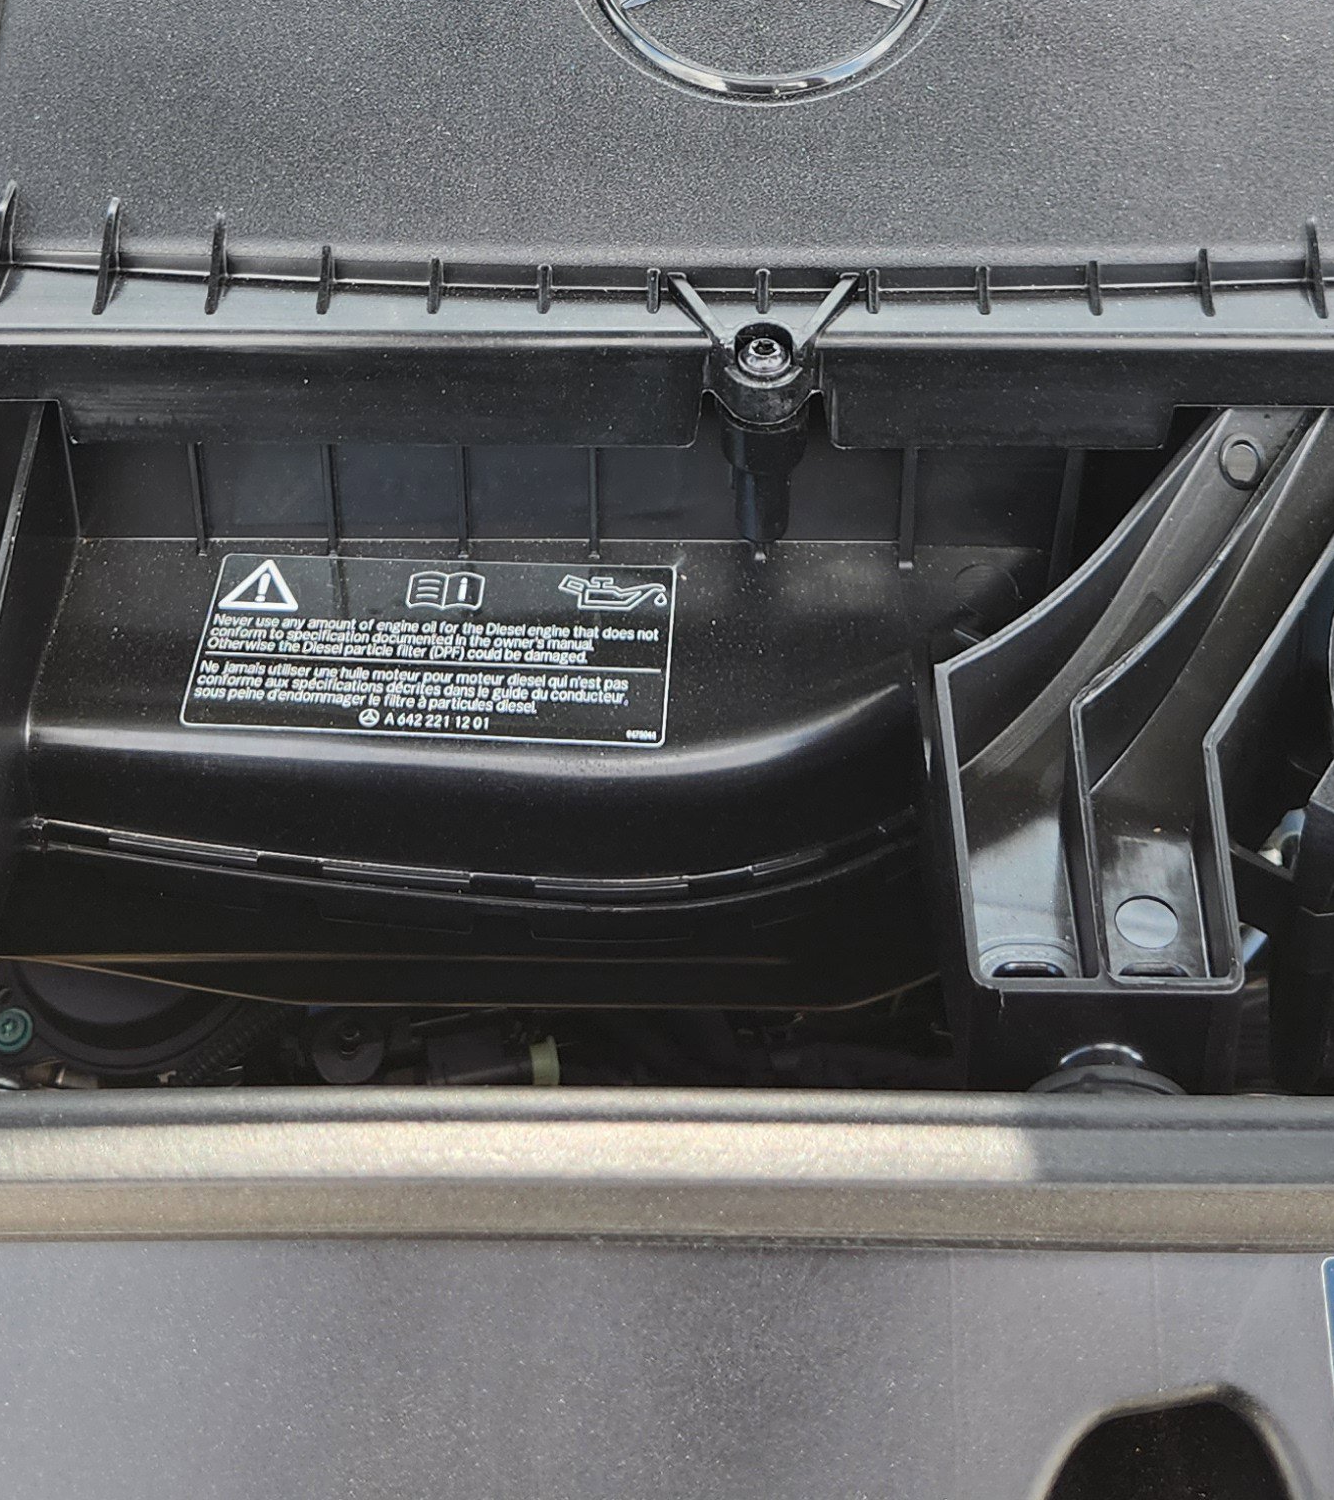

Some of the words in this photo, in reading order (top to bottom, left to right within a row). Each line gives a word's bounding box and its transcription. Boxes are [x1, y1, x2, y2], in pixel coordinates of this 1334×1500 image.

[209, 625, 267, 639] conform
[268, 627, 285, 639] to
[286, 628, 370, 644] specification
[371, 631, 453, 646] documented
[454, 634, 467, 647] in
[469, 635, 490, 648] the
[492, 636, 545, 650] owner's
[212, 613, 254, 627] Never
[254, 614, 279, 628] use
[280, 617, 305, 630] any
[306, 616, 356, 631] amount
[358, 618, 374, 631] of
[375, 619, 419, 634] engine
[421, 620, 437, 634] oil
[438, 621, 460, 635] for
[461, 622, 484, 636] the
[485, 623, 526, 637] Diesel
[527, 624, 570, 639] engine
[572, 626, 599, 640] that
[601, 627, 634, 641] does
[636, 628, 659, 642] not
[206, 637, 276, 651] Otherwise
[278, 640, 301, 652] the
[302, 641, 343, 654] Diesel
[344, 642, 394, 658] particle
[395, 644, 426, 658] filter
[429, 646, 465, 660] (DPF)
[466, 647, 502, 661] could
[503, 649, 522, 662] be
[523, 649, 587, 665] damaged.
[196, 672, 263, 687] conforme
[264, 675, 289, 688] aux
[290, 677, 384, 694] spécifications
[386, 681, 441, 695] décrites
[443, 683, 475, 697] dans
[477, 685, 489, 698] le
[492, 686, 528, 701] guide
[531, 687, 548, 700] du
[199, 660, 219, 673] Ne
[221, 661, 266, 676] jamais
[267, 663, 311, 677] utiliser
[313, 665, 339, 678] une
[340, 666, 370, 679] huile
[371, 667, 421, 682] moteur
[422, 671, 454, 684] pour
[455, 671, 504, 685] moteur
[506, 673, 546, 687] diesel
[547, 675, 567, 690] qui
[570, 676, 602, 690] n'est
[603, 678, 629, 692] pas
[192, 685, 227, 698] sous
[226, 687, 265, 702] peine
[266, 688, 366, 707] d'endommager
[368, 693, 381, 705] le
[383, 694, 415, 707] filtre
[417, 695, 426, 708] à
[428, 696, 494, 713] particules
[383, 712, 395, 725] A
[396, 712, 422, 726] 642
[424, 714, 449, 728] 221
[455, 715, 471, 729] 12
[472, 716, 489, 730] 01
